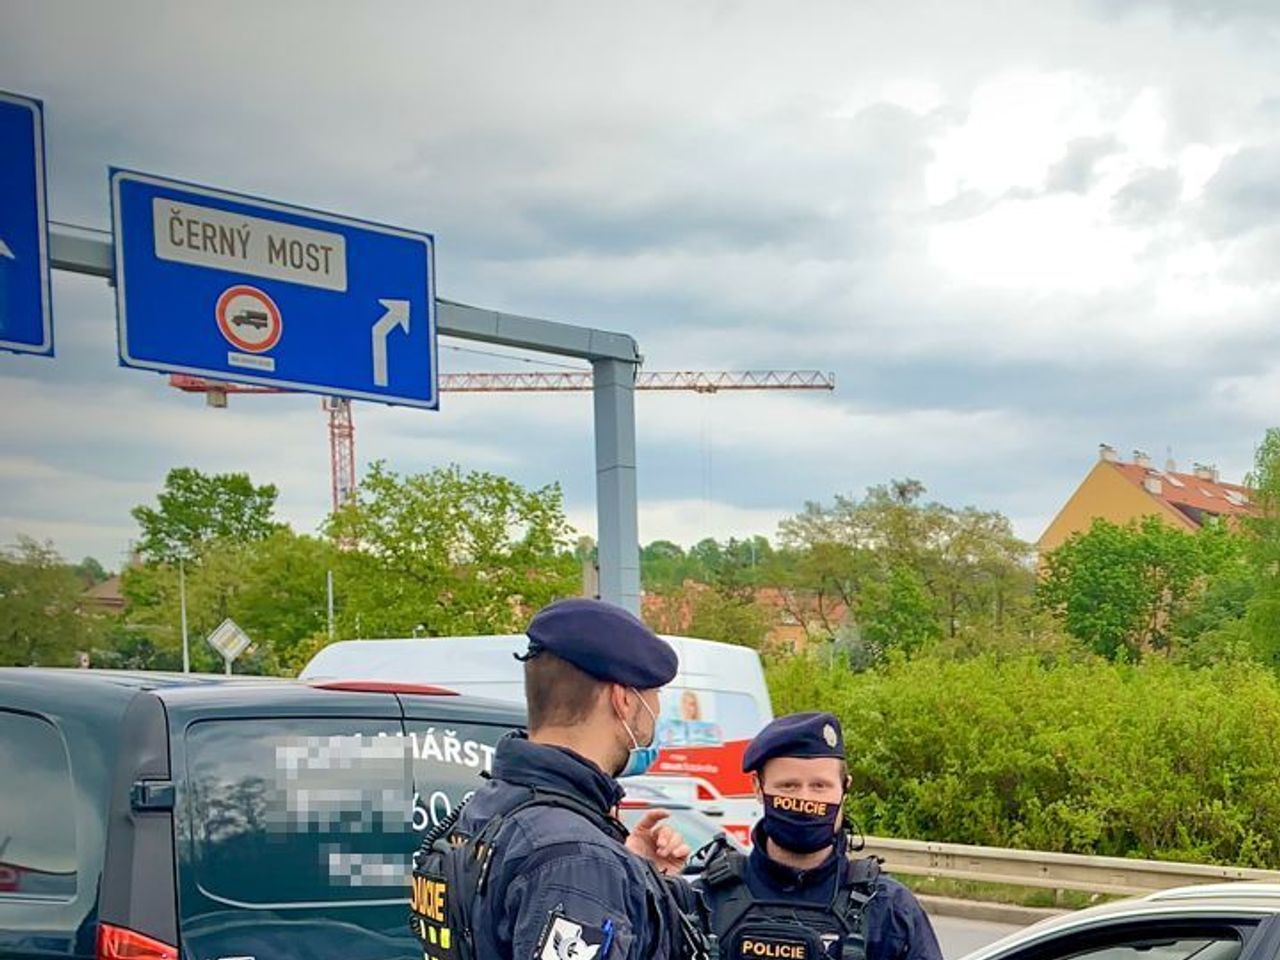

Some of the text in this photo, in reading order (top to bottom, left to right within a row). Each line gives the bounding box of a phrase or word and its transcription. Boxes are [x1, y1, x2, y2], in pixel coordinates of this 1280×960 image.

[168, 207, 333, 275] ČERNÝ MOST
[773, 796, 827, 816] POLICIE
[742, 940, 805, 960] POLICIE
